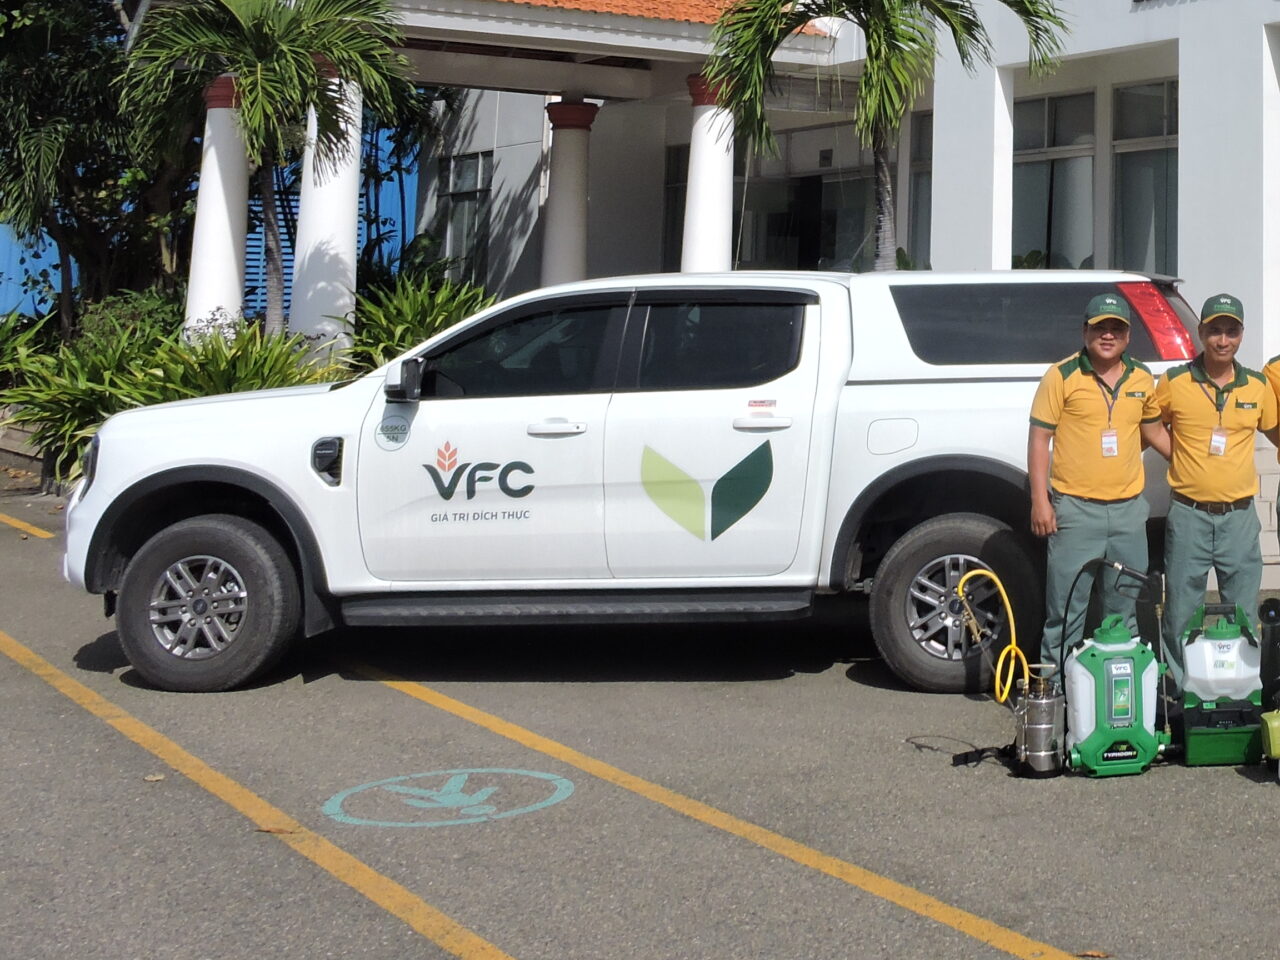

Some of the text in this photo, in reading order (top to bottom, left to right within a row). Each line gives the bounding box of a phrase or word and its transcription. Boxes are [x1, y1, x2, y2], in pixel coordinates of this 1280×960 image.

[422, 460, 535, 501] VFC
[430, 512, 449, 523] GIÁ
[452, 512, 470, 523] TRỊ
[501, 510, 530, 520] THỰC
